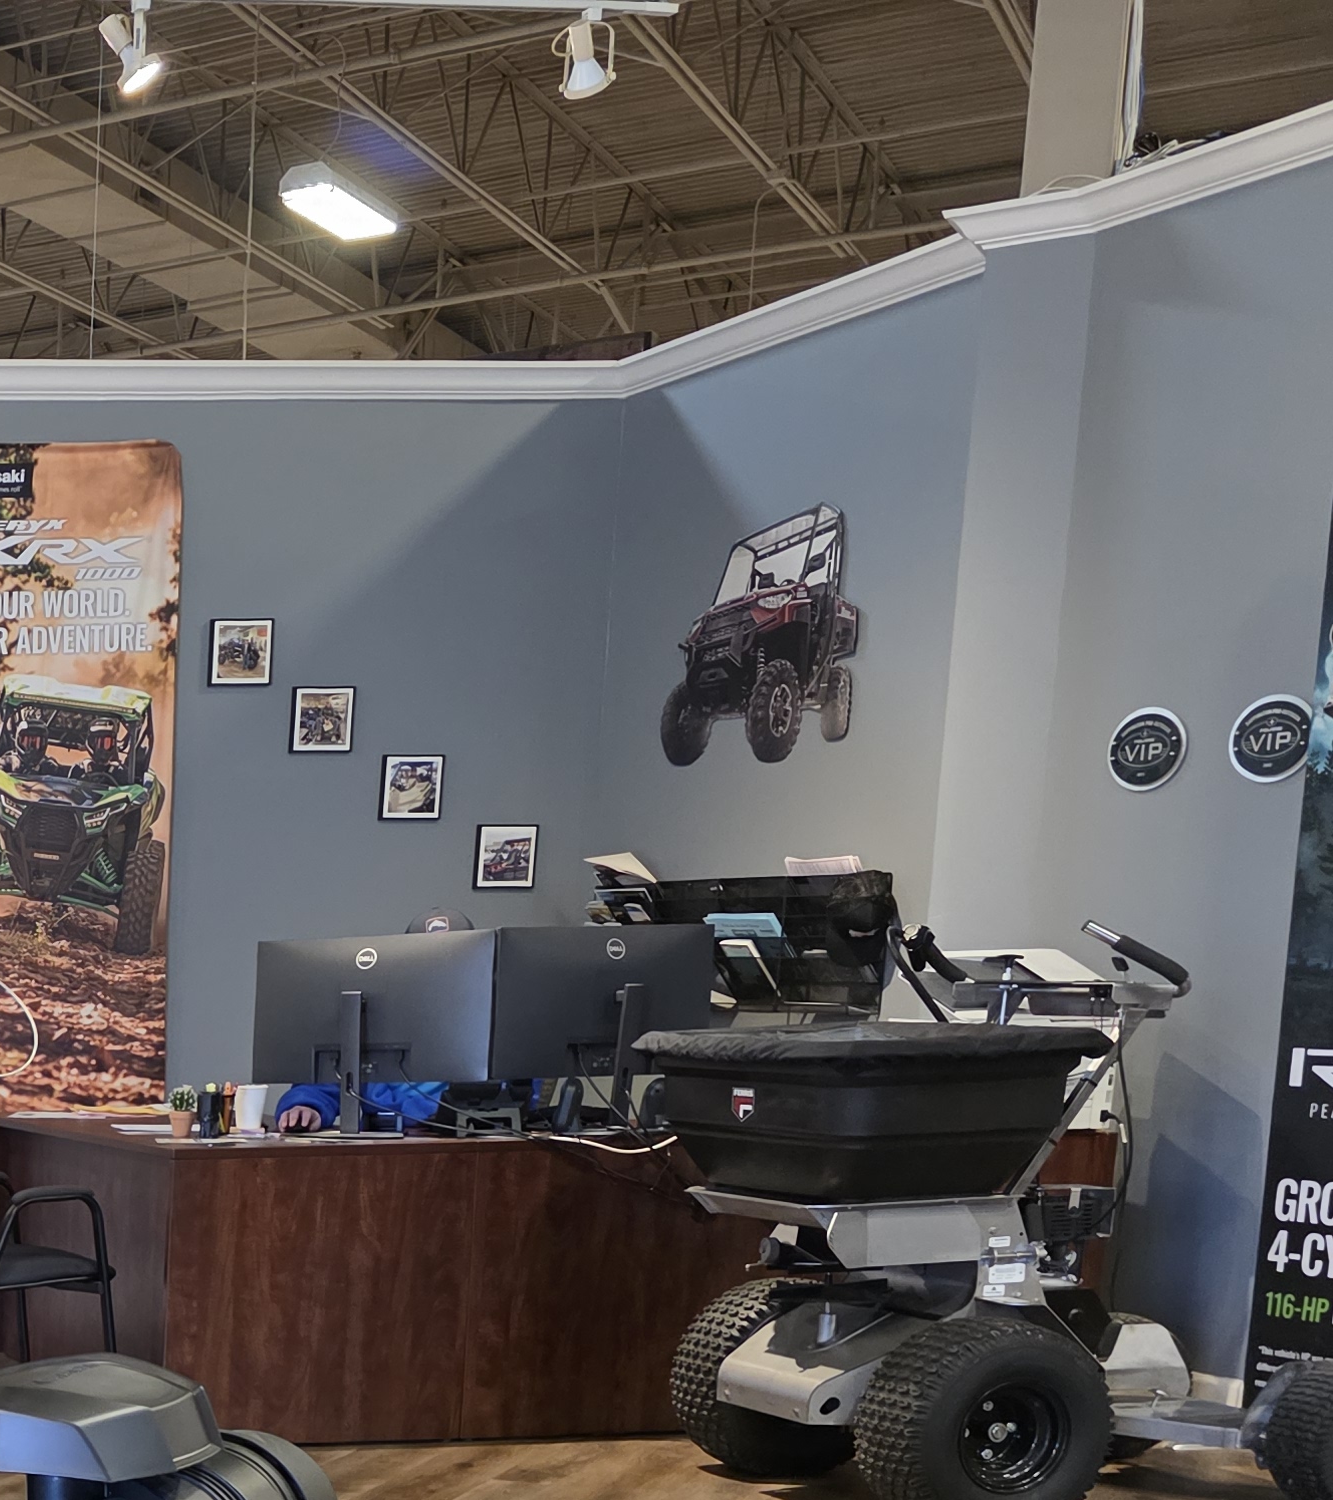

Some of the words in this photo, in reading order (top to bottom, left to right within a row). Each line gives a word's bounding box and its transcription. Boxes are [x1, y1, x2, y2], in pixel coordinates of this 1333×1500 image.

[75, 566, 143, 581] 1000
[43, 588, 131, 619] WORLD.
[15, 623, 152, 656] ADVENTURE.
[1125, 742, 1163, 762] VIP
[1249, 730, 1292, 752] VIP
[358, 954, 374, 962] DELL
[1274, 1177, 1333, 1226] GRO
[1265, 1291, 1330, 1323] 116-HP
